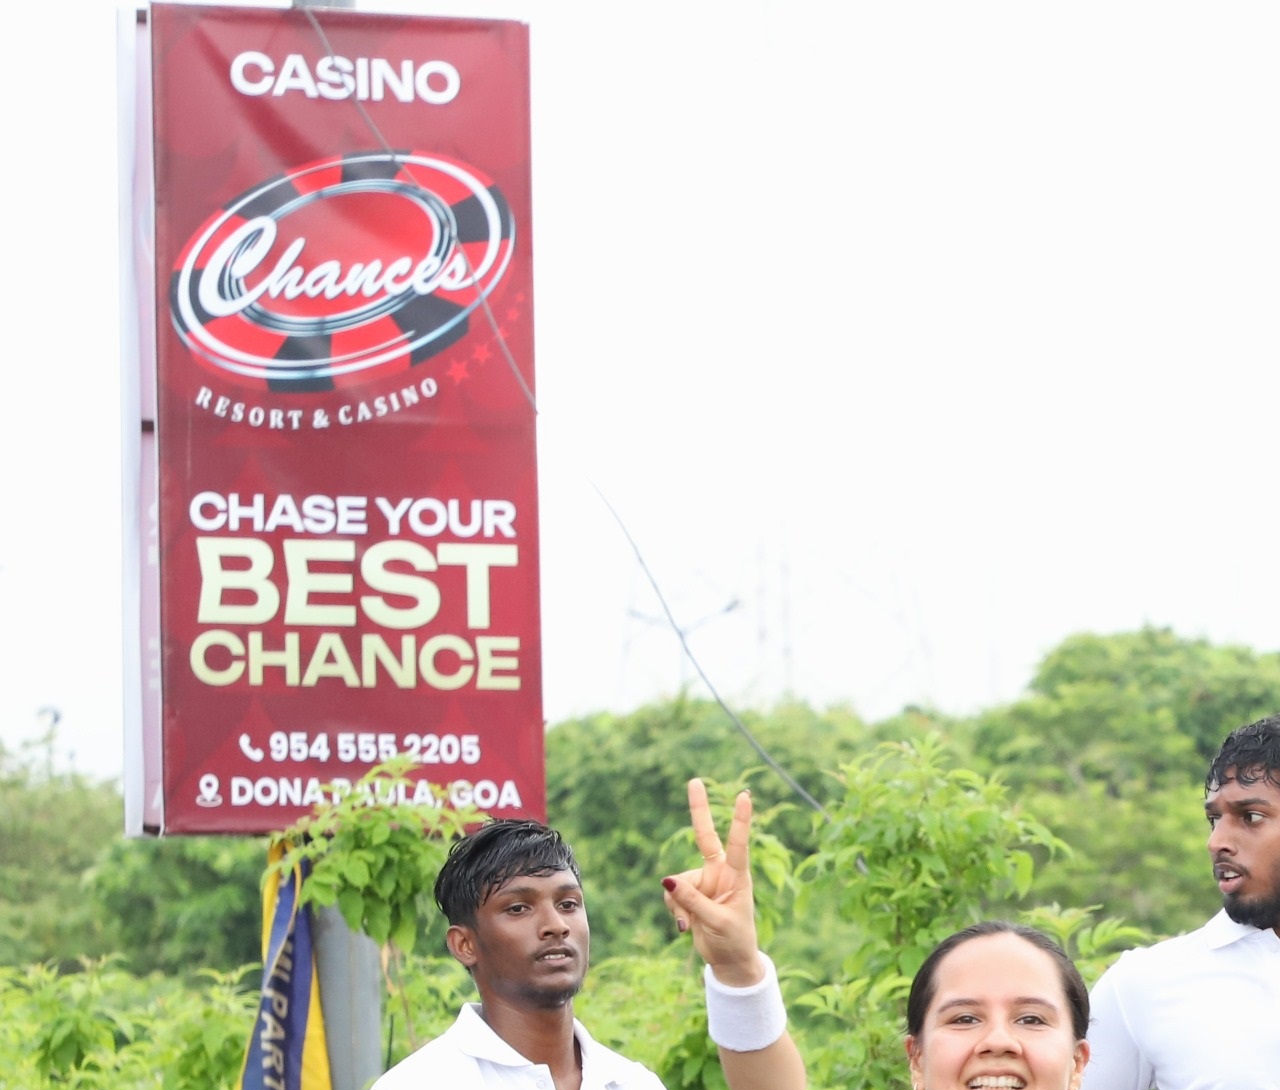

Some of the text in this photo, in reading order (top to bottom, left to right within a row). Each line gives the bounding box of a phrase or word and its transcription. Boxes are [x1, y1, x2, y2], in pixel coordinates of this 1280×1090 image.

[230, 51, 461, 105] CASINO
[198, 216, 478, 317] Chances
[195, 377, 438, 430] RESORT & CASINO
[189, 491, 368, 534] CHASE
[374, 496, 517, 538] YOUR
[196, 537, 519, 630] BEST
[189, 629, 521, 690] CHANCE
[269, 731, 481, 764] 954 555 2205
[230, 776, 324, 807] DONA
[449, 780, 523, 810] GOA
